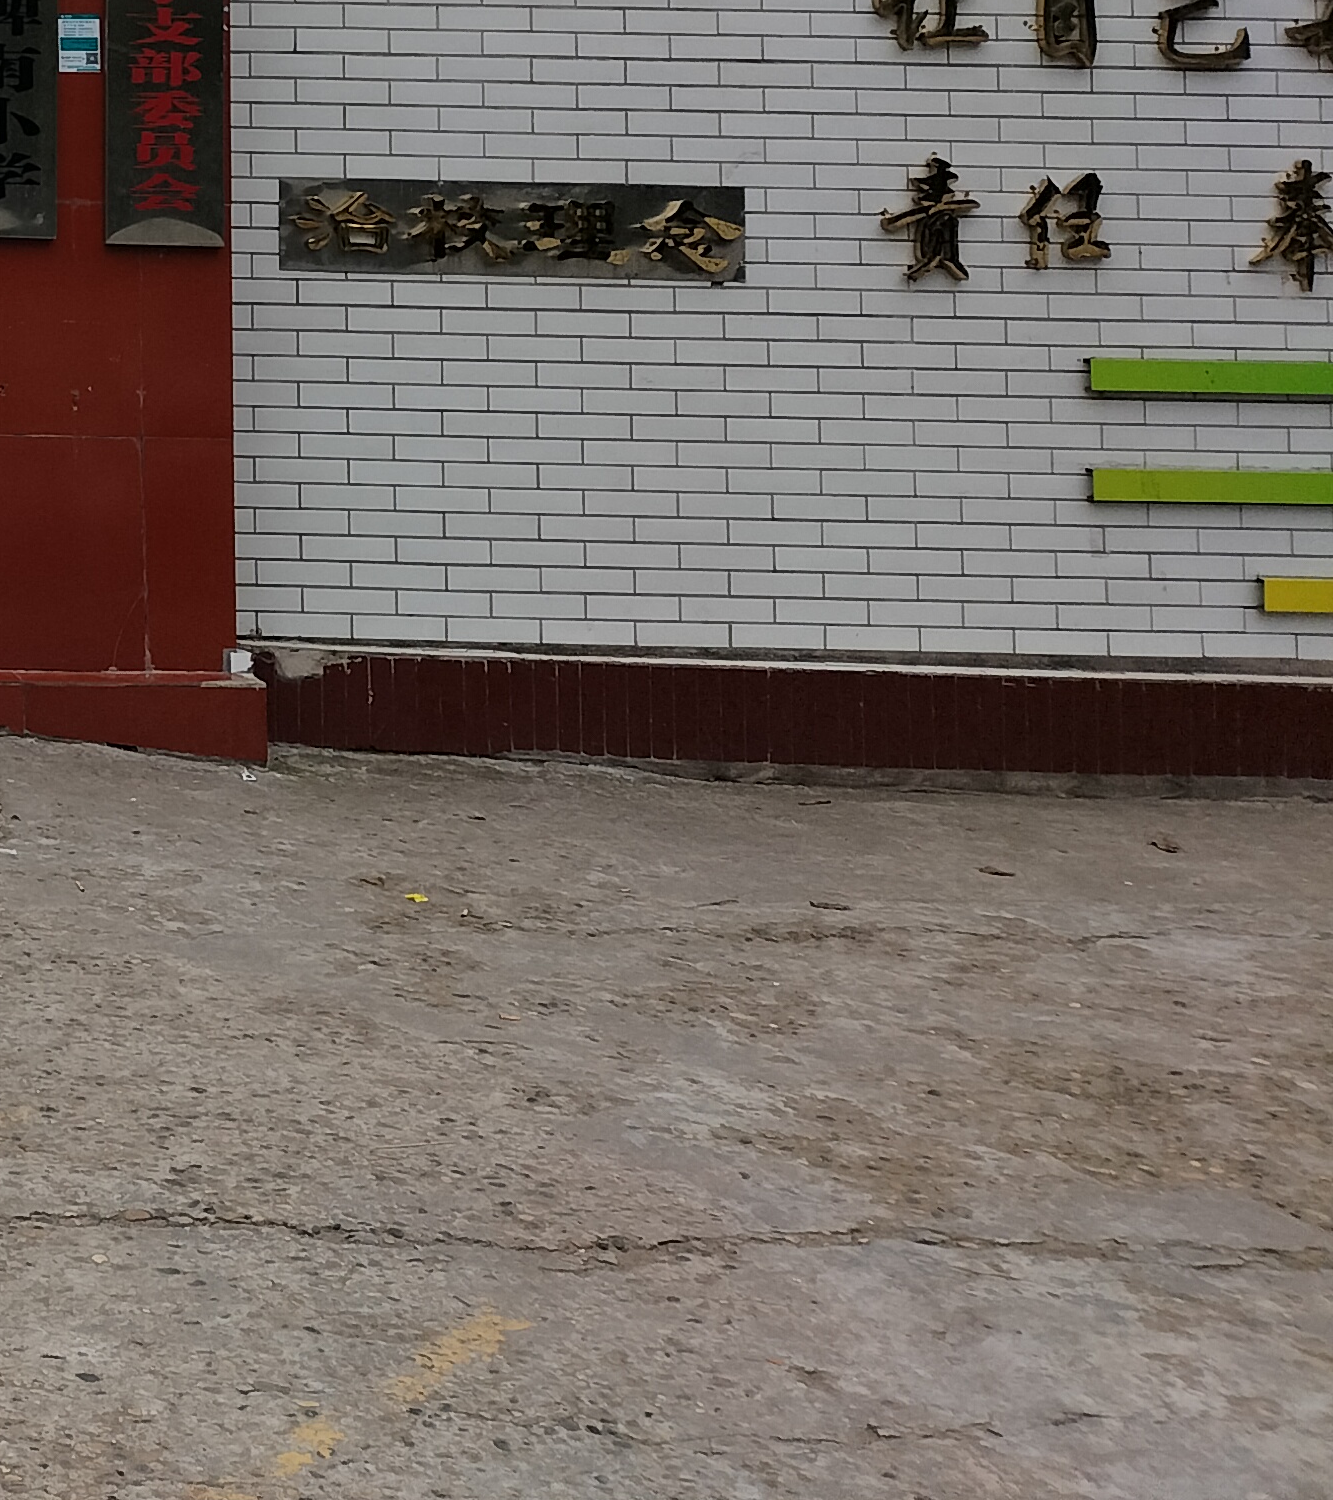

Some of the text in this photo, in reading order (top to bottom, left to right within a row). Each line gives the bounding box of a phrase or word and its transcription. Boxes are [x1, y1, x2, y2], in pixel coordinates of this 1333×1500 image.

[291, 188, 744, 274] 治校理念
[880, 152, 1112, 283] 责任
